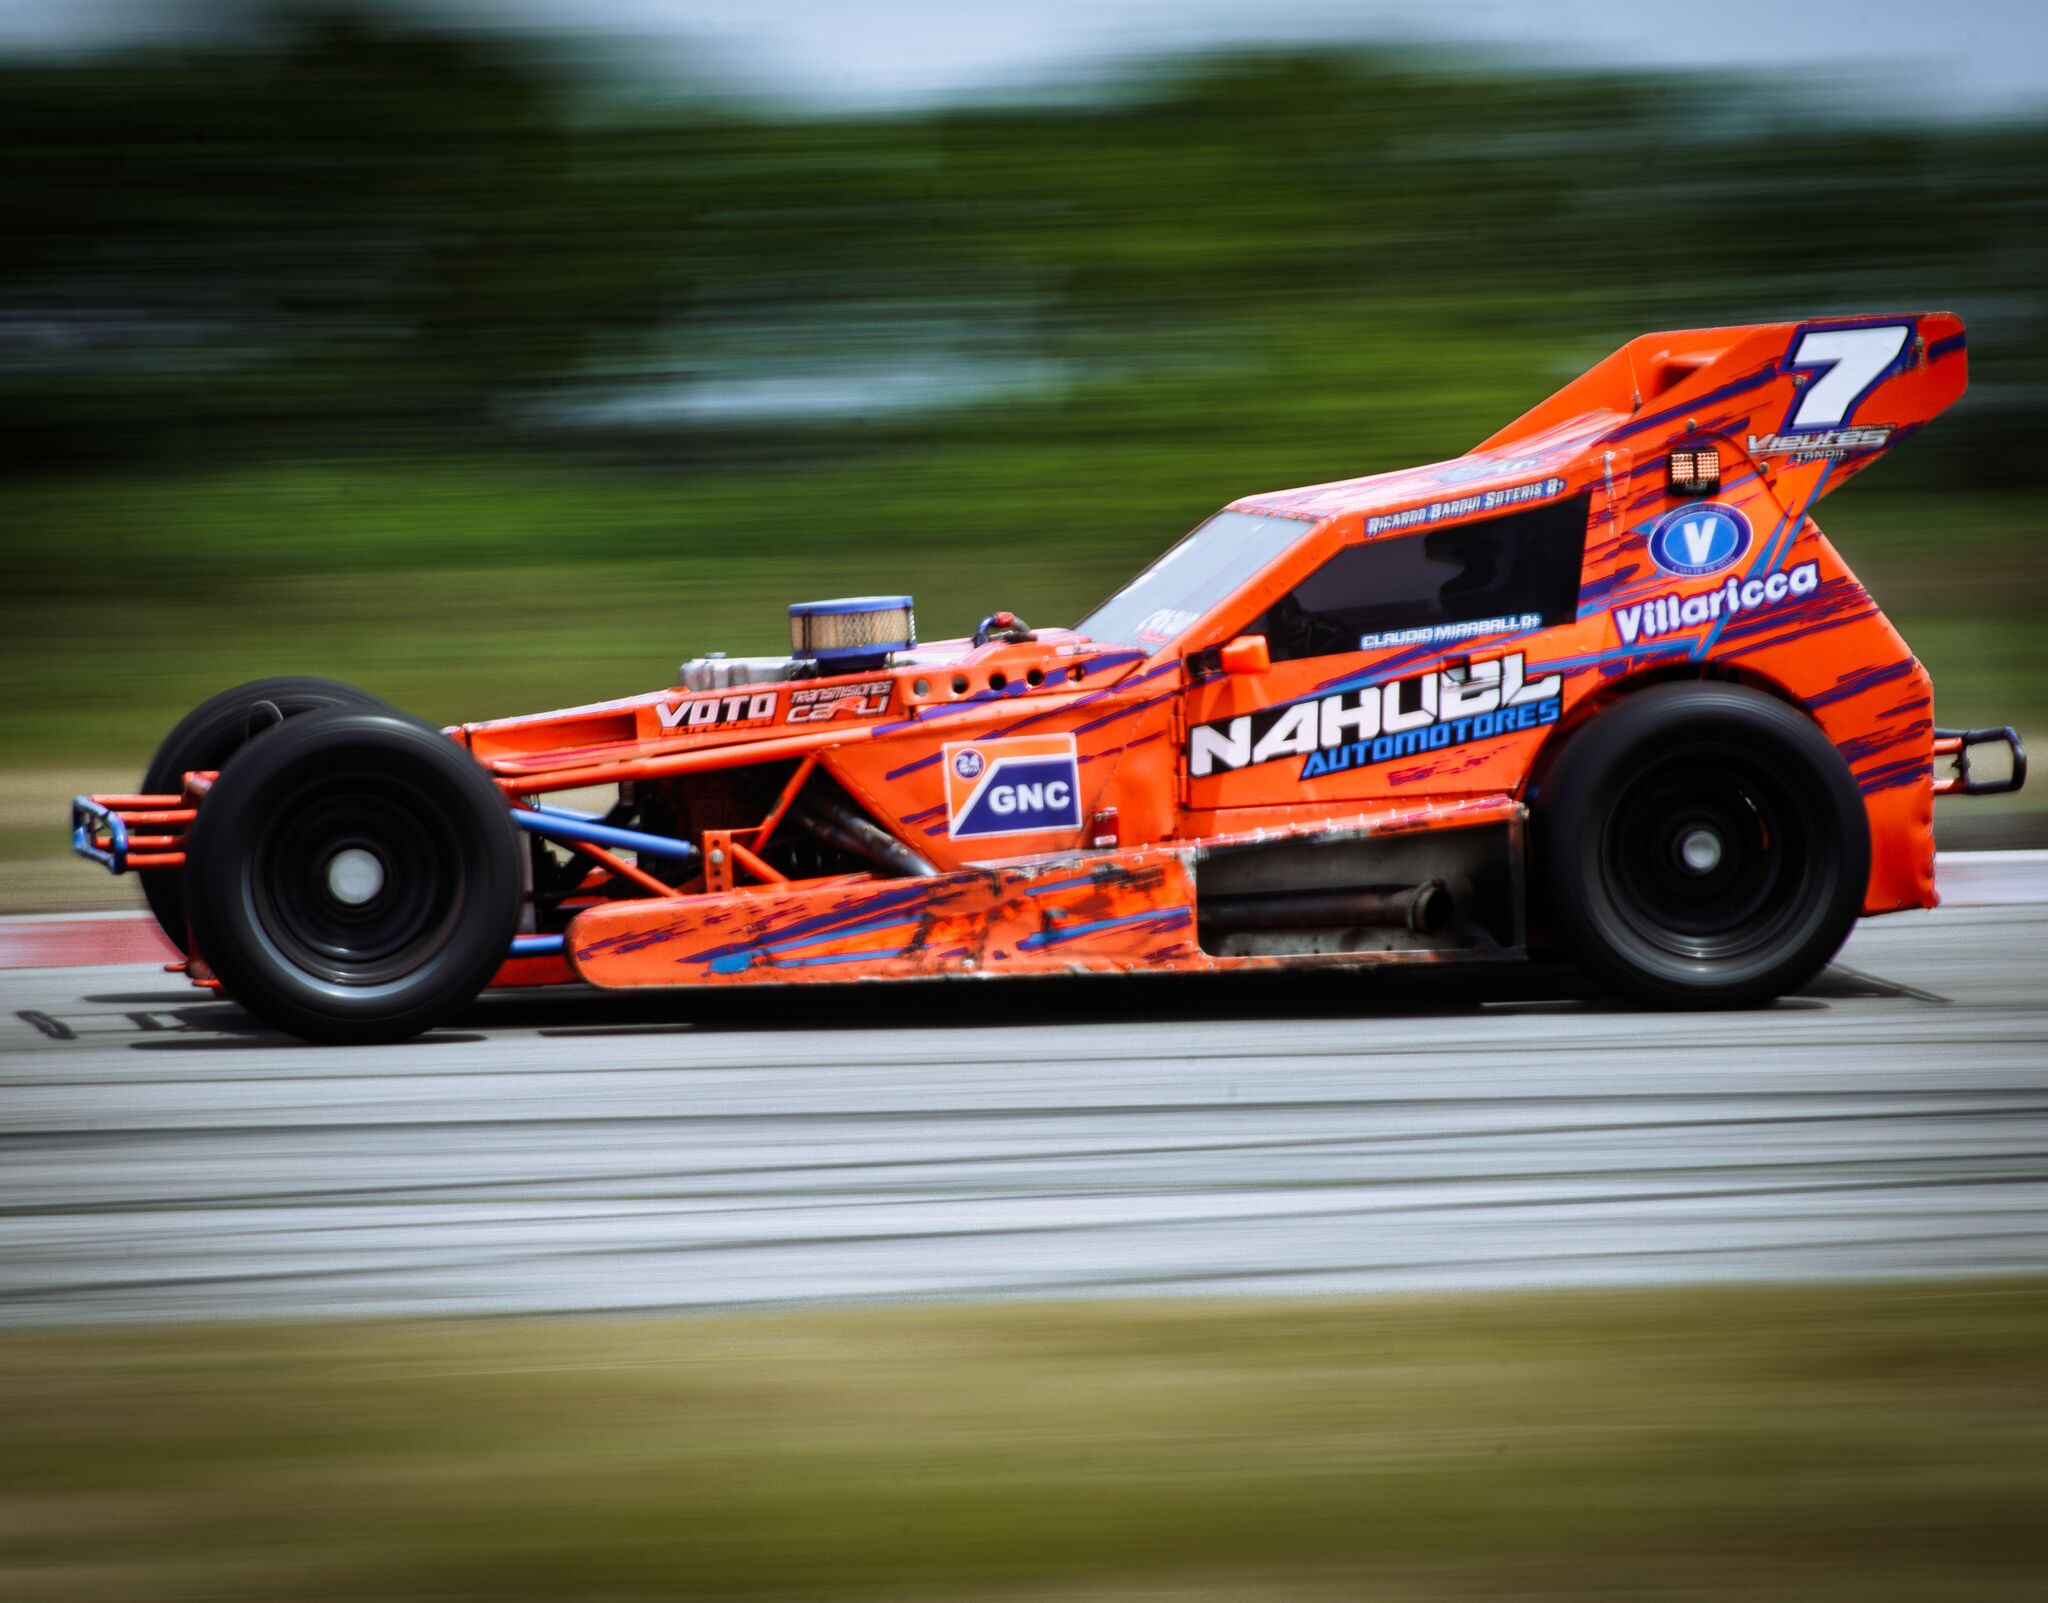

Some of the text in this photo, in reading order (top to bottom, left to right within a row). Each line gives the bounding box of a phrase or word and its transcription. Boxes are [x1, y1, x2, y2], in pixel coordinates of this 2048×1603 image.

[1792, 325, 1909, 426] 7
[1796, 449, 1847, 461] TANDIL
[1683, 517, 1718, 565] V
[1615, 563, 1819, 644] Villaricca
[1362, 629, 1434, 650] CLAUDIO
[655, 691, 778, 728] VOTO
[1190, 651, 1562, 777] NAHUEL
[1300, 698, 1562, 779] AUTOMOTORES
[987, 780, 1071, 816] GNC
